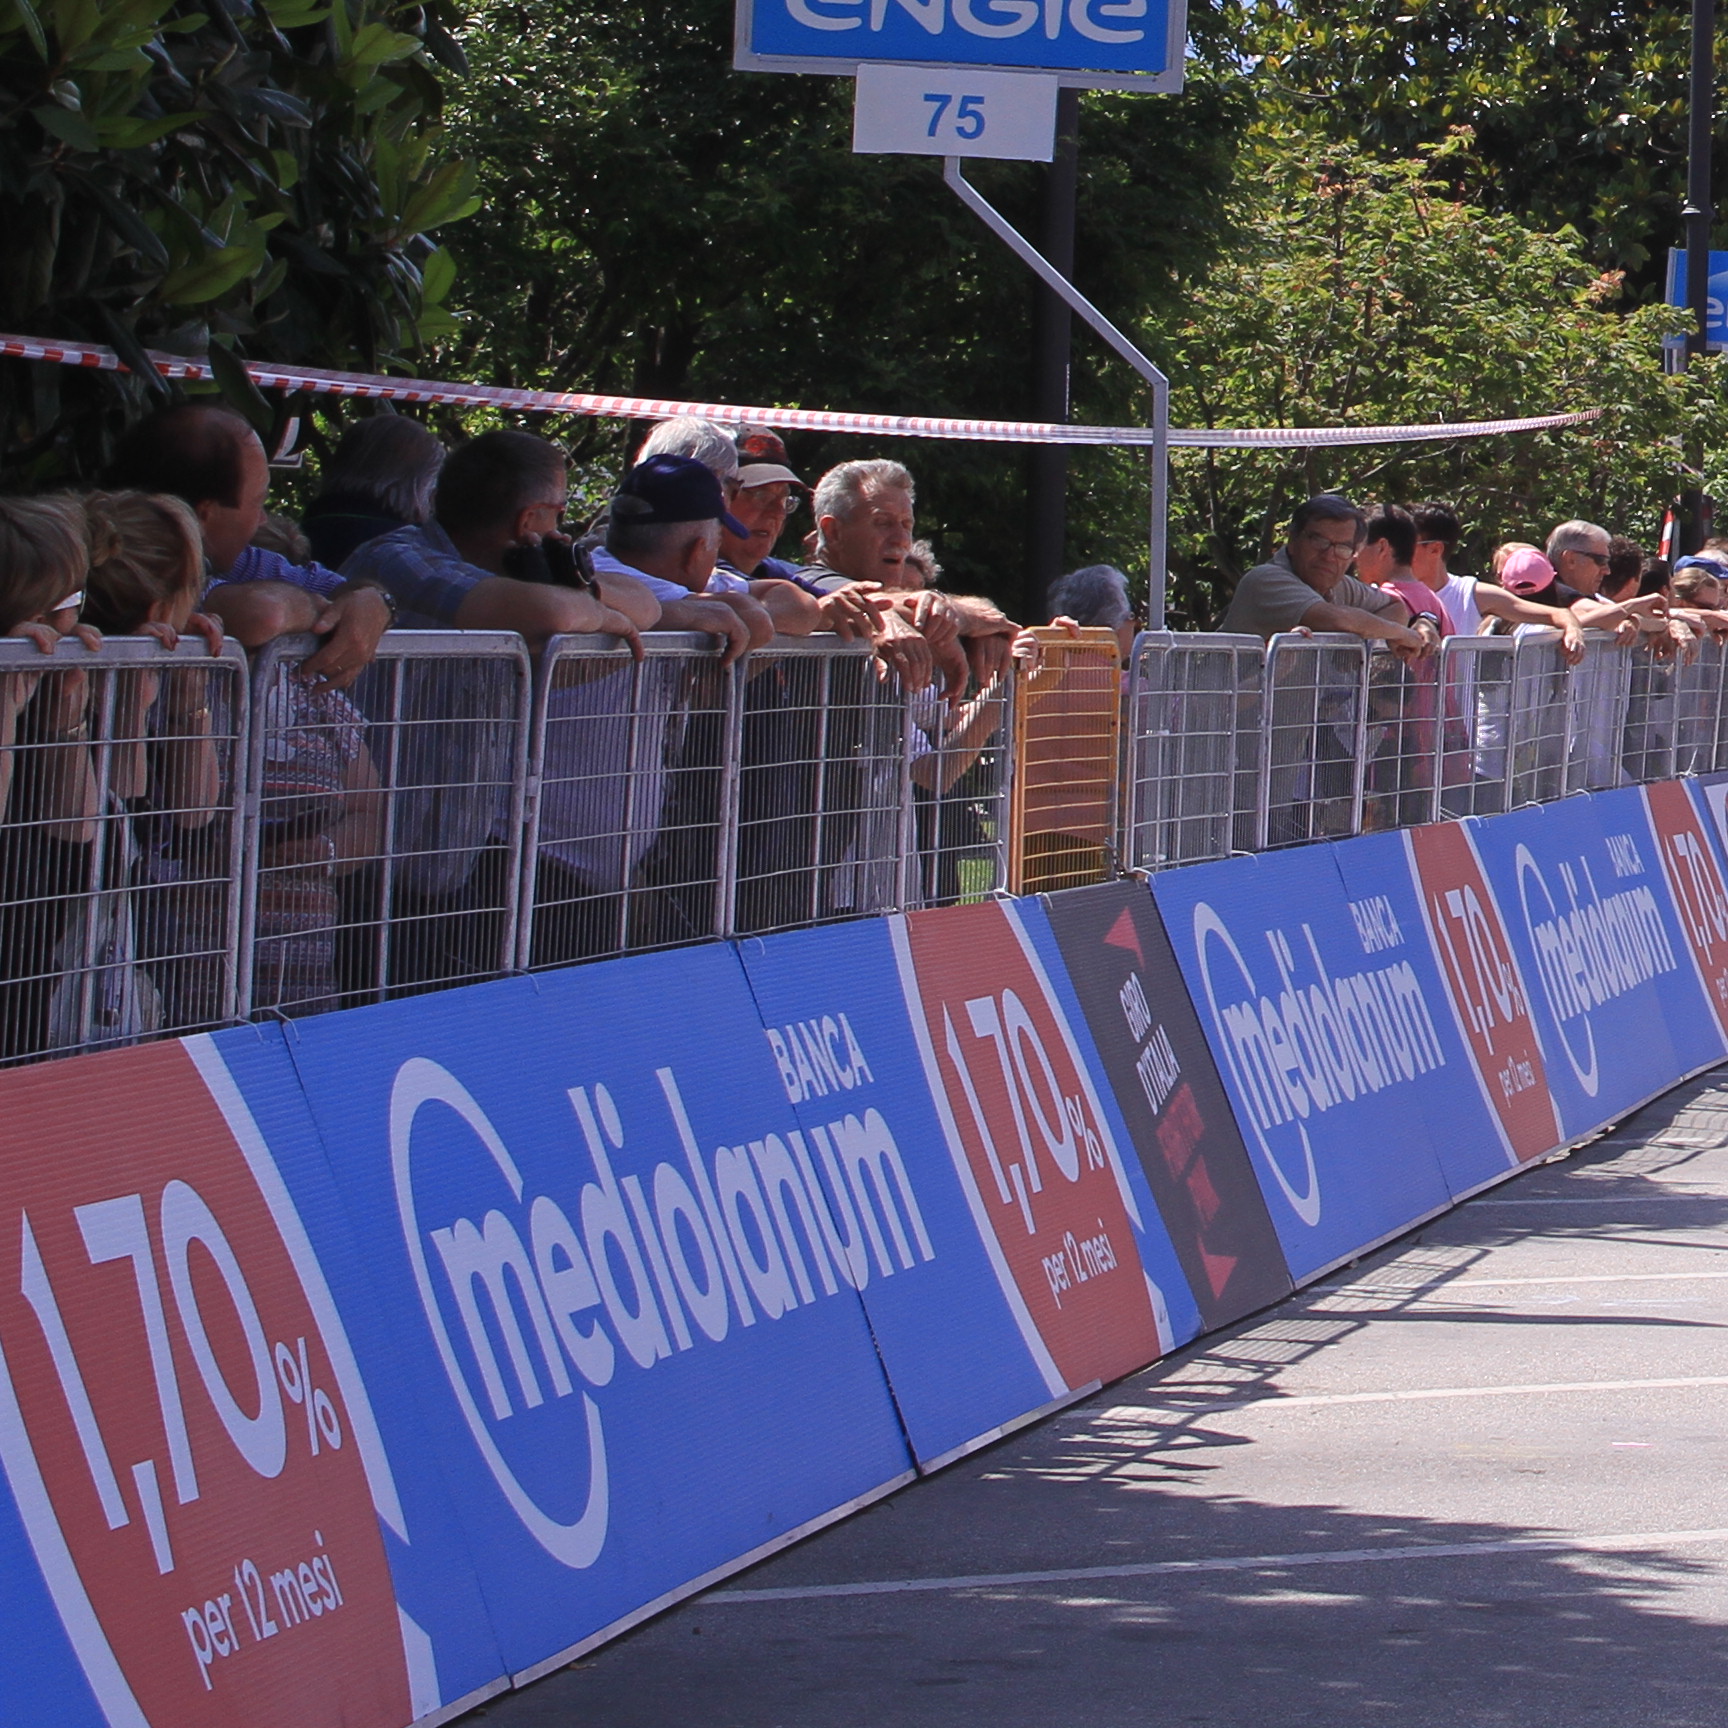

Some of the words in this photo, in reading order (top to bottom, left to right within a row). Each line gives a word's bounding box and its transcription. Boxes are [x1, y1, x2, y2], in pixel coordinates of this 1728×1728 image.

[923, 93, 986, 140] 75
[1348, 894, 1404, 954] BANCA
[1435, 883, 1526, 1057] 1,70%
[1534, 855, 1677, 1022] mediolanum
[765, 1012, 874, 1104] BANCA
[1120, 972, 1151, 1043] GIRO
[1136, 1024, 1181, 1115] D'ITALIA
[1222, 922, 1446, 1130] mediolanum
[942, 988, 1104, 1236] 1,70%
[431, 1067, 935, 1421] mediolanum
[1041, 1251, 1071, 1310] per
[1064, 1231, 1088, 1283] 12
[1080, 1217, 1118, 1276] mesi
[21, 1178, 343, 1576] 1,70%
[181, 1593, 240, 1691] per
[234, 1559, 279, 1642] 12
[270, 1530, 344, 1626] mesi
